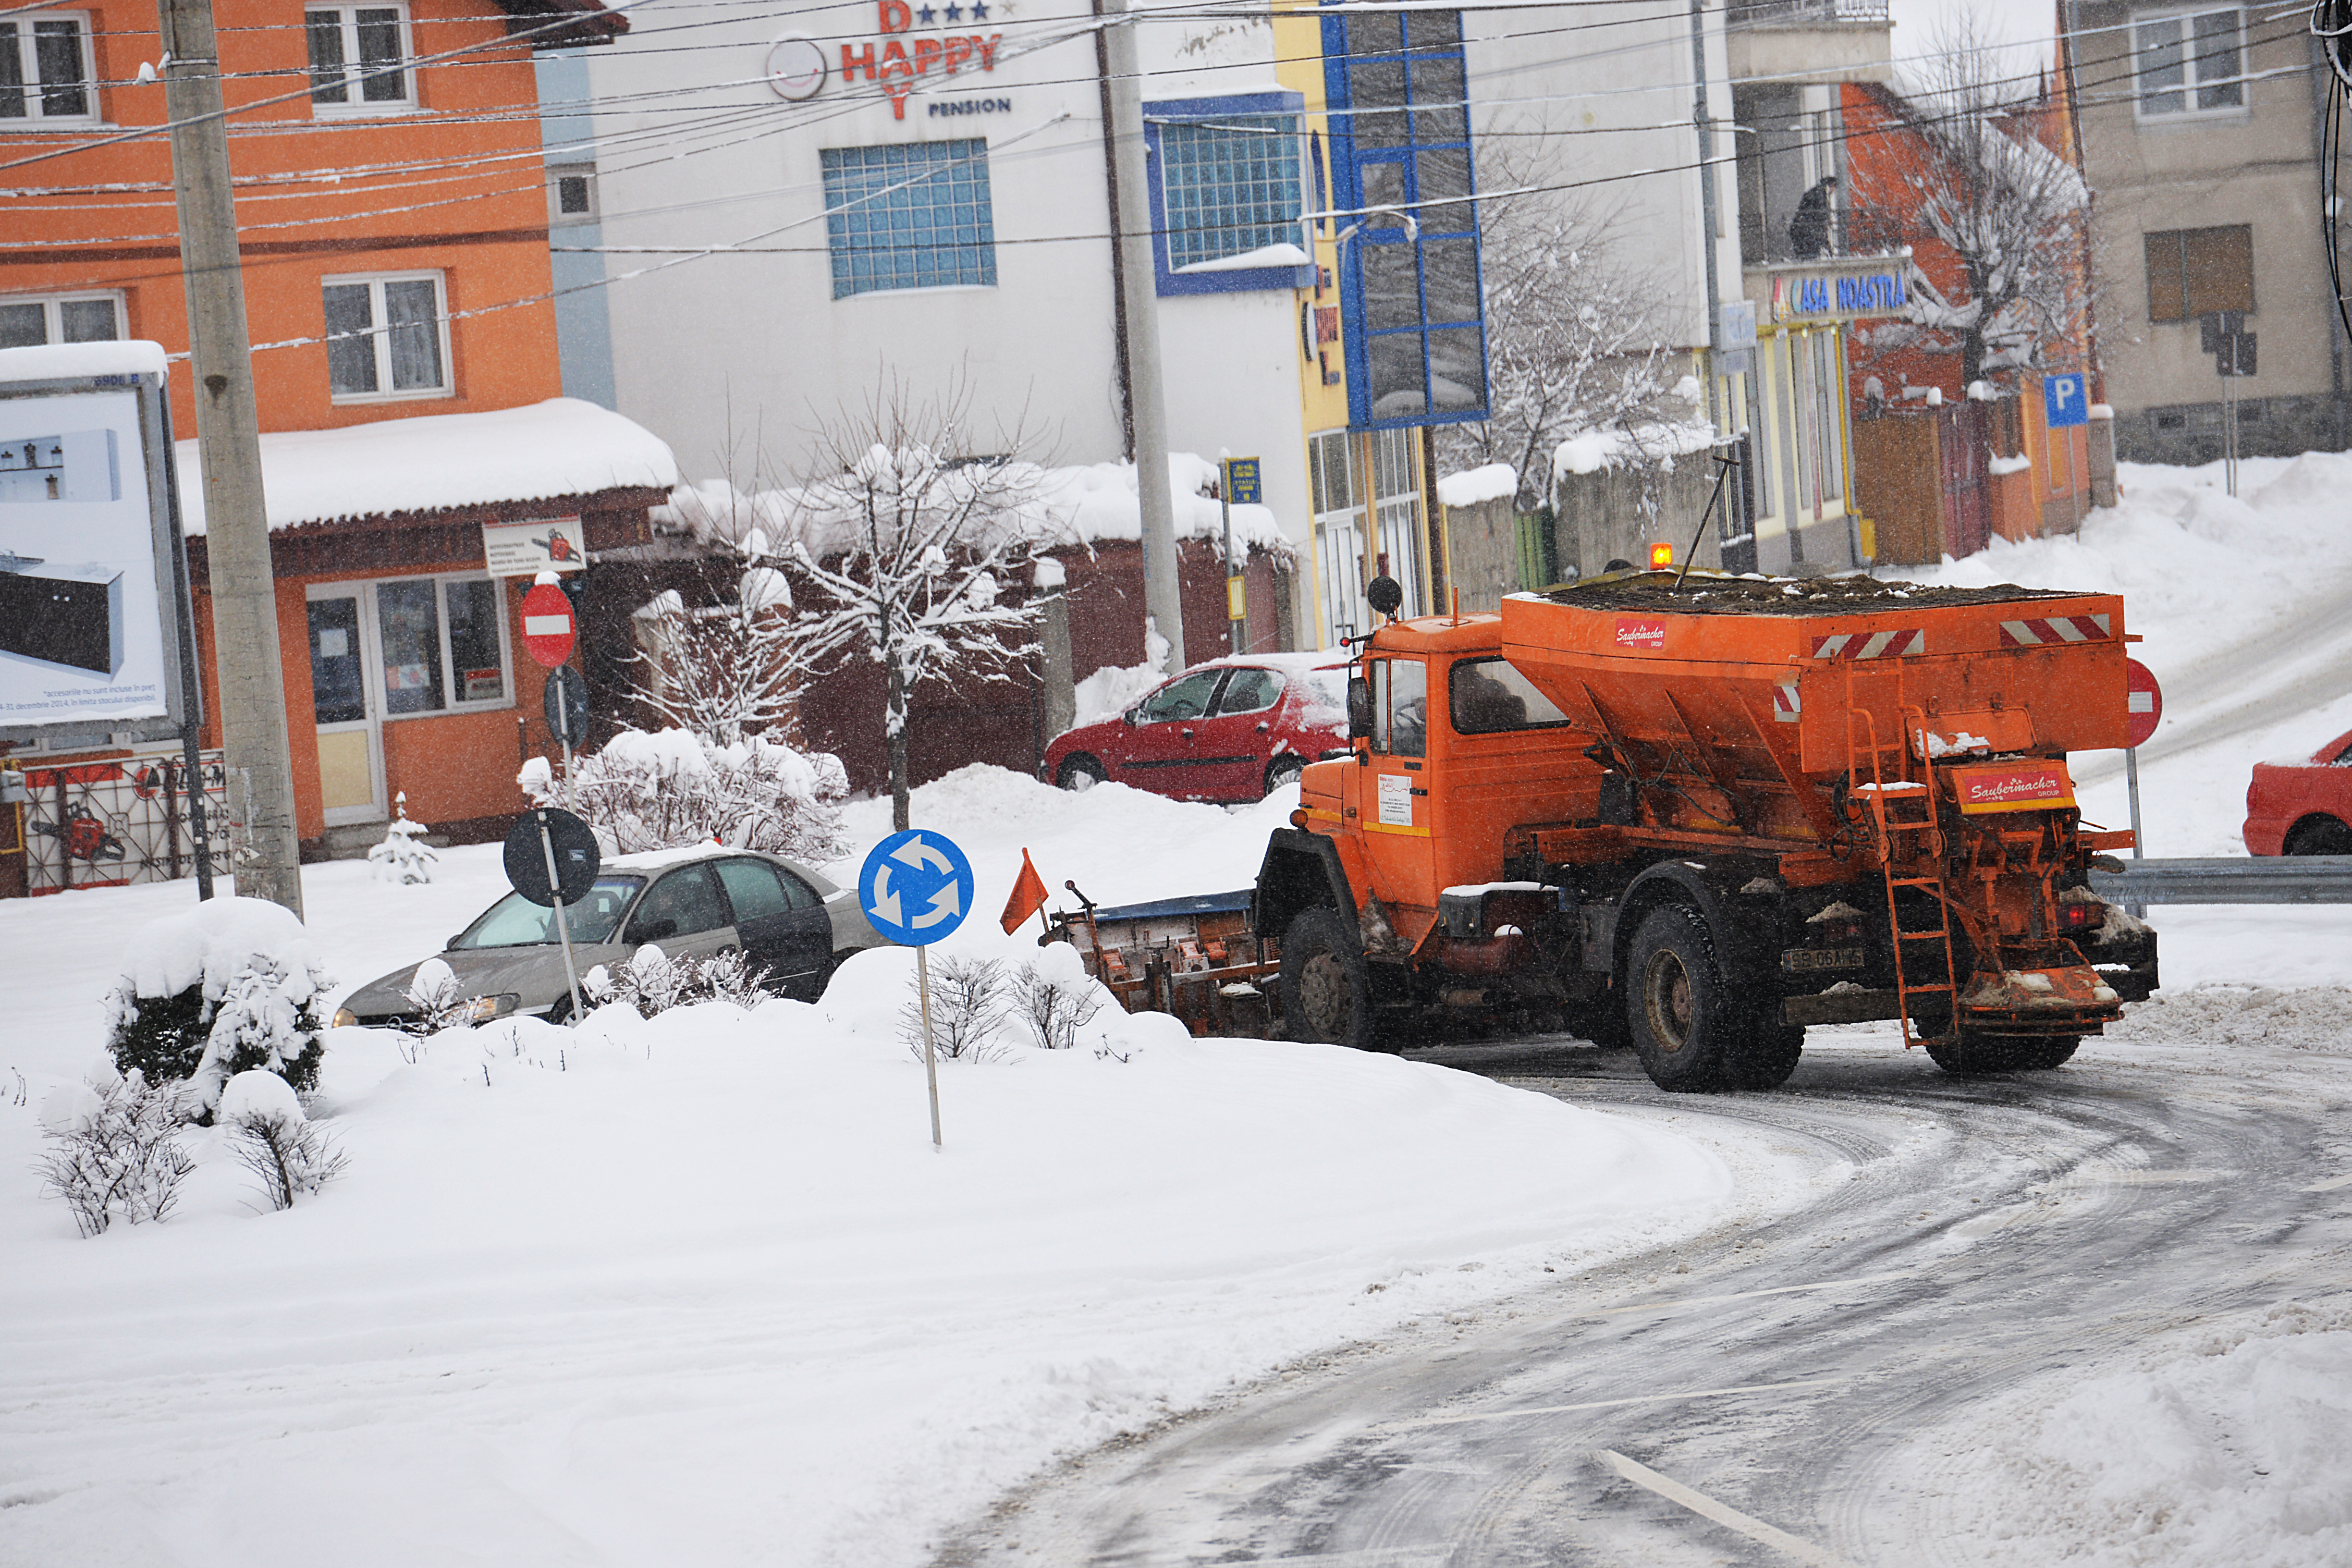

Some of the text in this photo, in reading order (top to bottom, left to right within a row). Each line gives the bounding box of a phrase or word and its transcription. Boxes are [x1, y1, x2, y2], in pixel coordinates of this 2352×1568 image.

[841, 33, 1002, 81] HAPPY
[928, 98, 1011, 117] PENSION
[1791, 277, 1830, 313] CASA
[2055, 378, 2074, 410] P
[1616, 626, 1664, 642] Saubermacher
[16, 701, 49, 710] decembrie
[97, 696, 124, 705] stocului
[1971, 776, 2057, 799] Saubermacher
[1792, 952, 1811, 968] SB
[1816, 951, 1833, 966] 06
